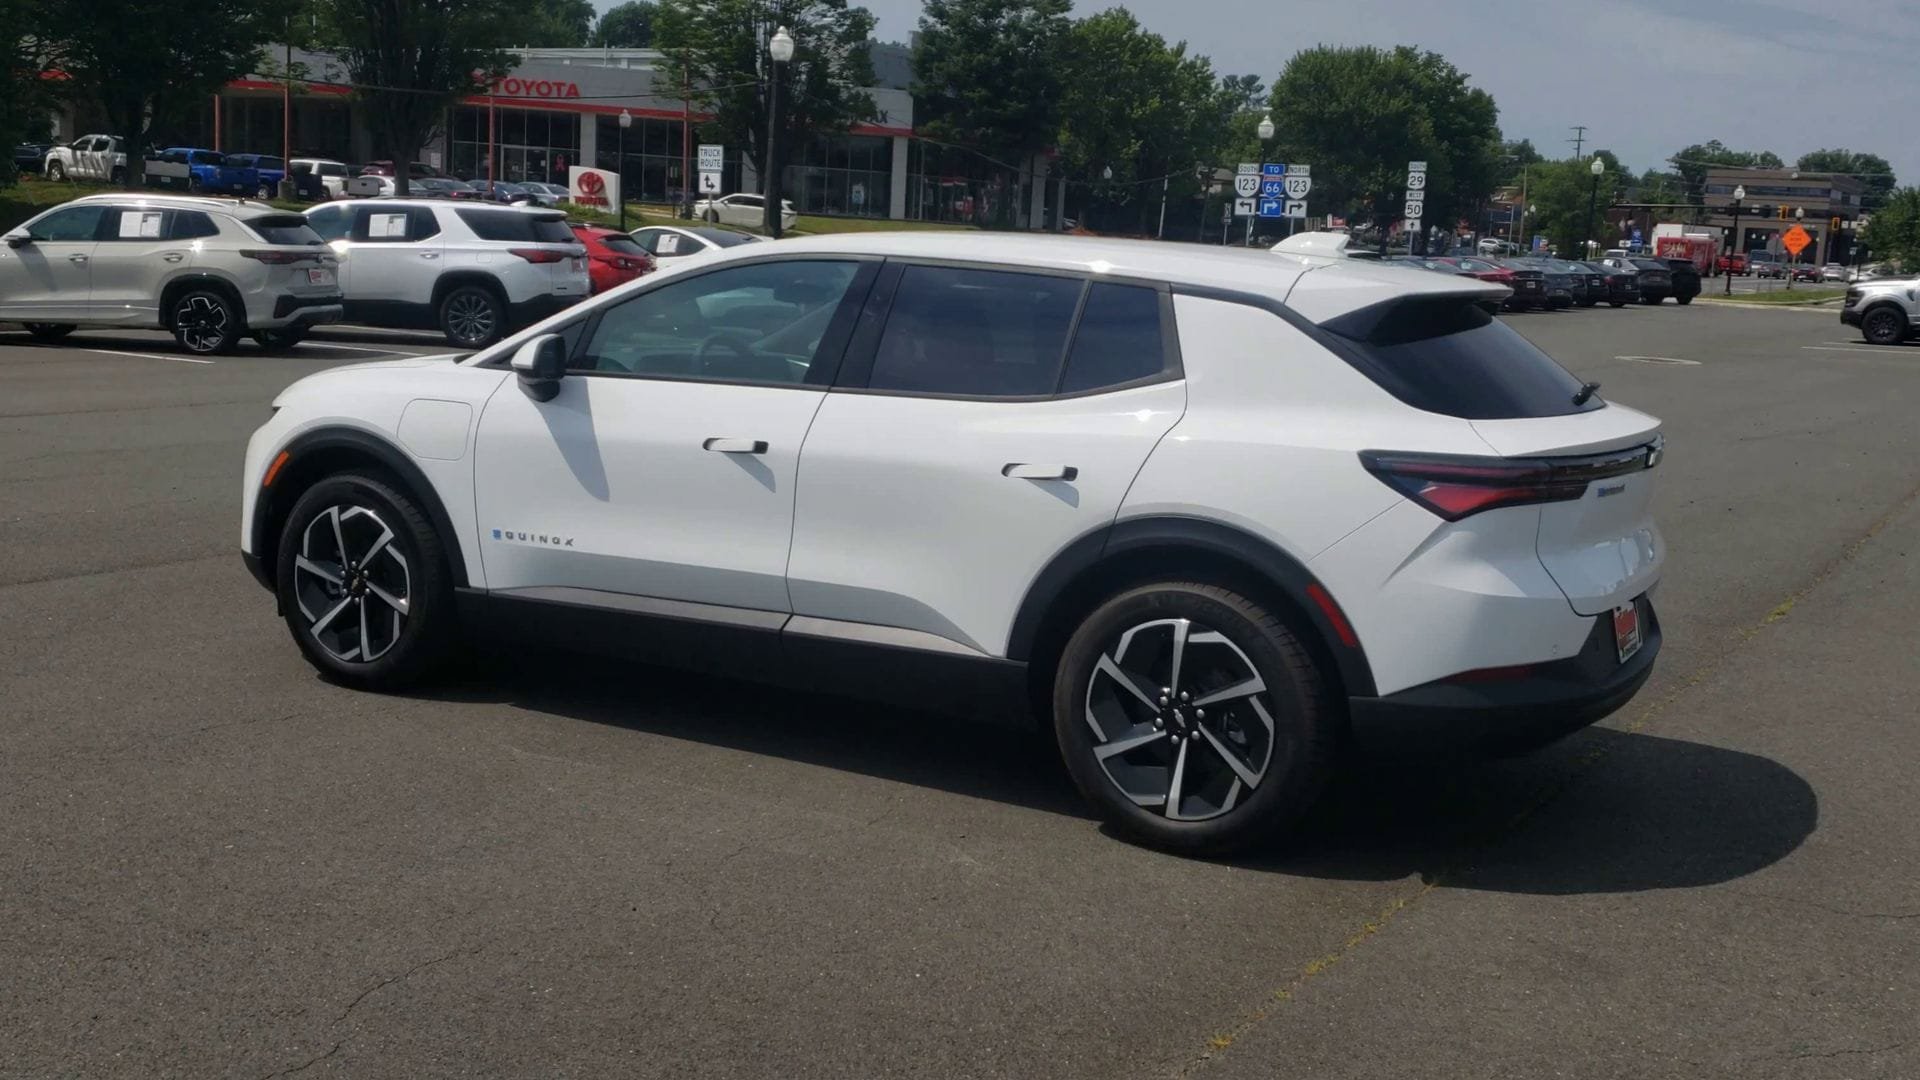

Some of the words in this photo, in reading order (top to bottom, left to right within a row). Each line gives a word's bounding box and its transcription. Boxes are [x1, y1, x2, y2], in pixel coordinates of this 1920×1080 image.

[490, 77, 580, 97] TOYOTA
[700, 148, 721, 157] TRUCK
[700, 158, 721, 168] ROUTE
[1239, 164, 1258, 172] SOUTH
[1269, 166, 1280, 174] TO
[1288, 166, 1309, 175] NORTH
[1238, 178, 1257, 191] 123
[1409, 175, 1424, 186] 29
[1265, 182, 1280, 194] 66
[1288, 180, 1307, 193] 123
[1406, 204, 1421, 215] 50
